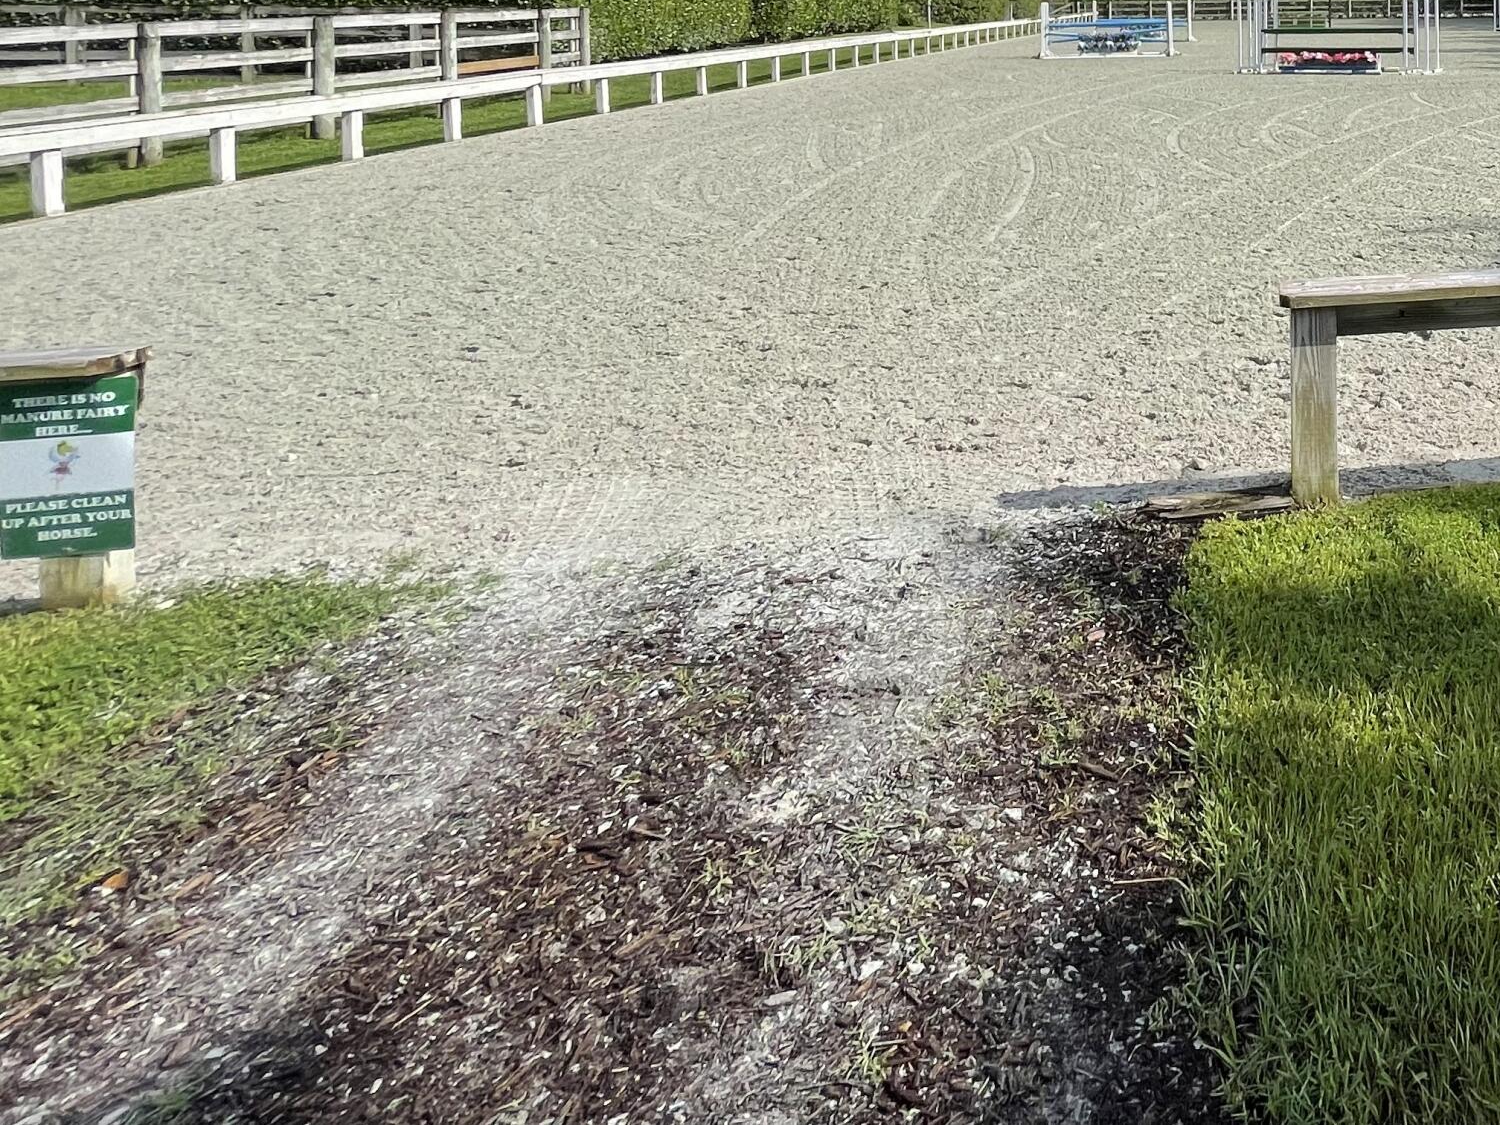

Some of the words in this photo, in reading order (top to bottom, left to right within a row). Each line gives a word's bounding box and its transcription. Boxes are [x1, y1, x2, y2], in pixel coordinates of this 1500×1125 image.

[12, 394, 69, 408] THERE
[71, 394, 87, 405] IS
[90, 391, 116, 403] NO
[0, 409, 74, 424] MANURE
[76, 404, 130, 420] FAIRY
[5, 499, 69, 514] PLEASE
[71, 494, 127, 508] CLEAN
[1, 518, 24, 529] UP
[27, 513, 82, 527] AFTER
[85, 509, 132, 522] YOUR
